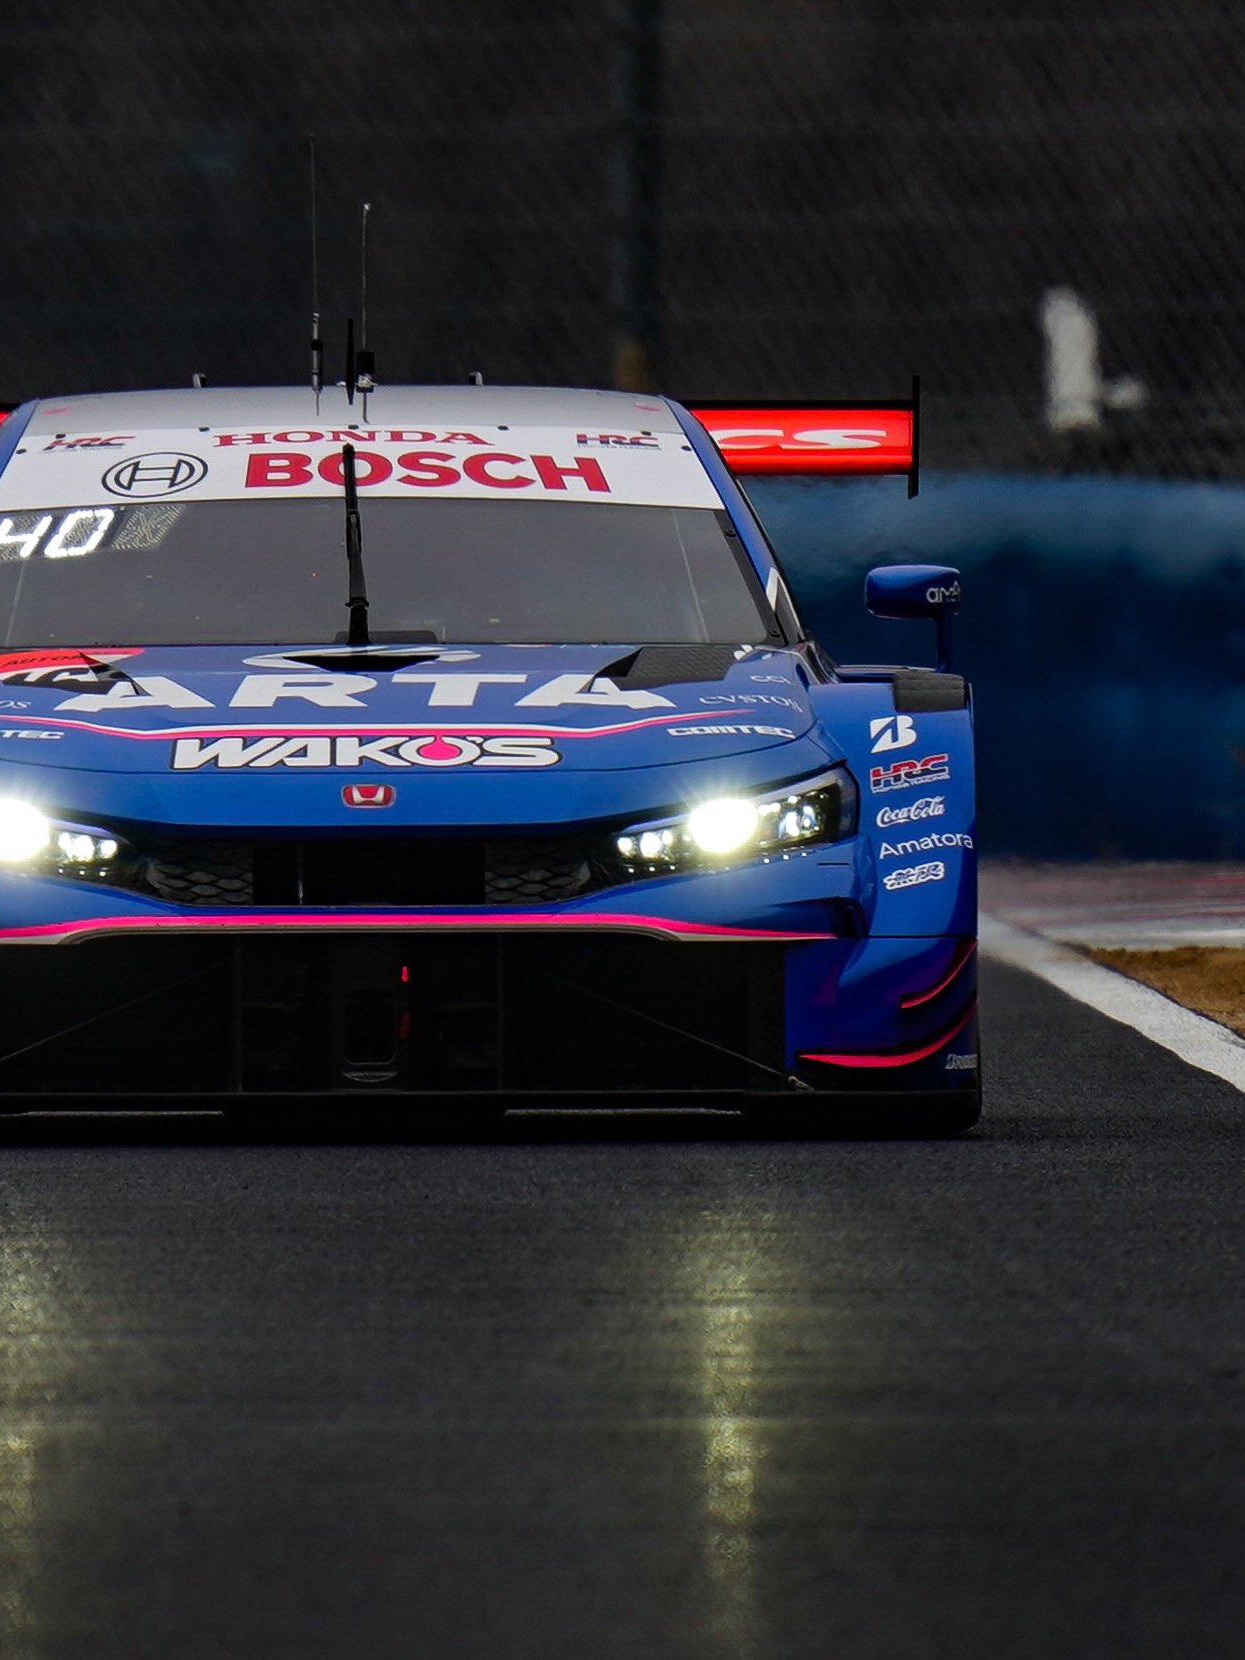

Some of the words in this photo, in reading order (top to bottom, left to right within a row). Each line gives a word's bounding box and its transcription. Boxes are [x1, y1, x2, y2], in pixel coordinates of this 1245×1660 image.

[213, 429, 495, 448] HONDA
[244, 451, 612, 493] BOSCH
[53, 673, 678, 712] ARTA
[666, 725, 797, 740] COMTEC
[870, 753, 949, 790] HRC
[879, 832, 974, 860] Amatora
